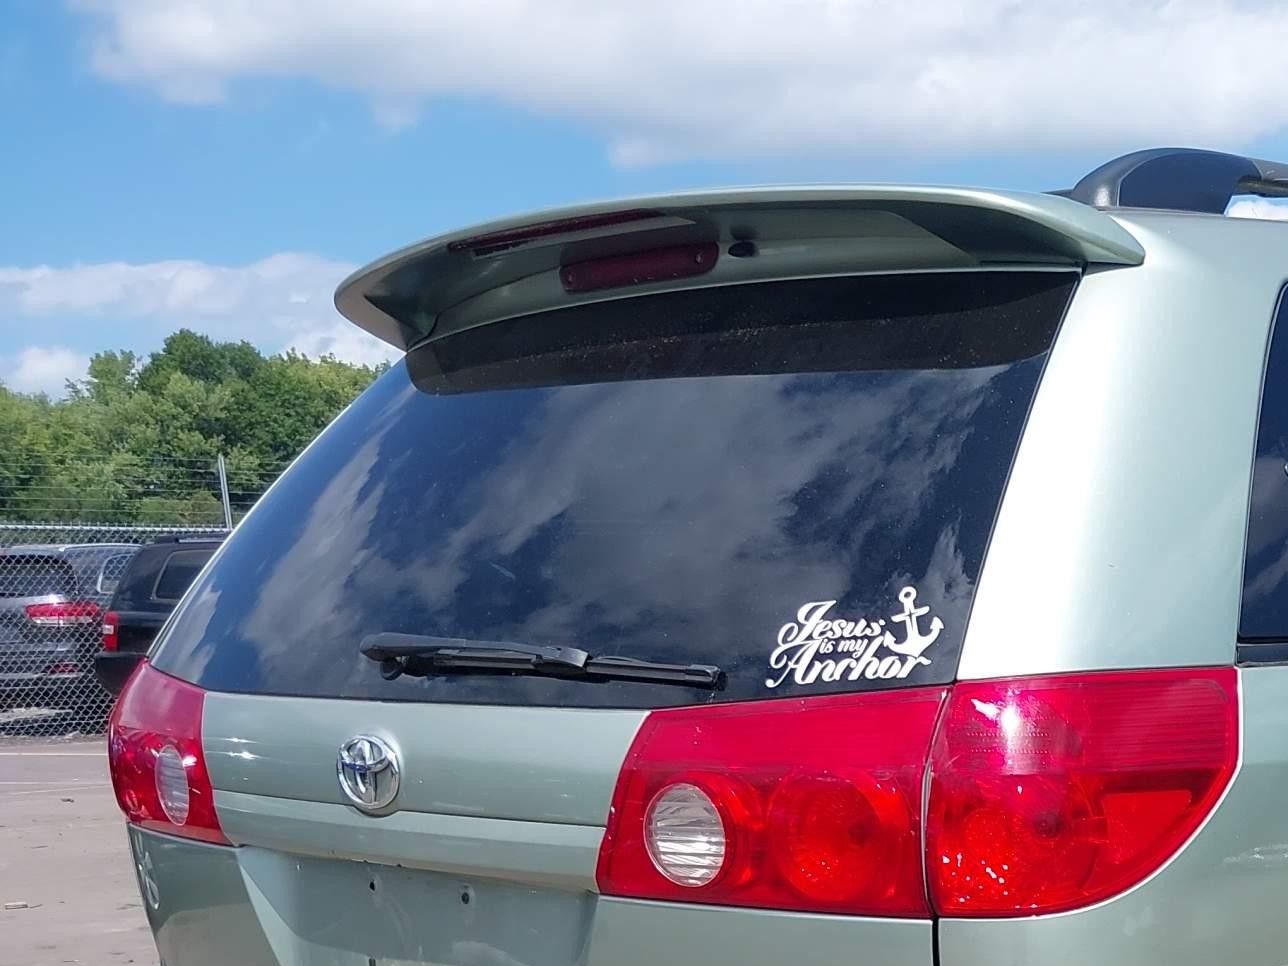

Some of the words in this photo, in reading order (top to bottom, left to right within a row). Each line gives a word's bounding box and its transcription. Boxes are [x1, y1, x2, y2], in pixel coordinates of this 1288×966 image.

[777, 600, 885, 645] Jesus
[765, 636, 932, 688] Anchor
[820, 638, 836, 654] is
[838, 638, 870, 658] my
